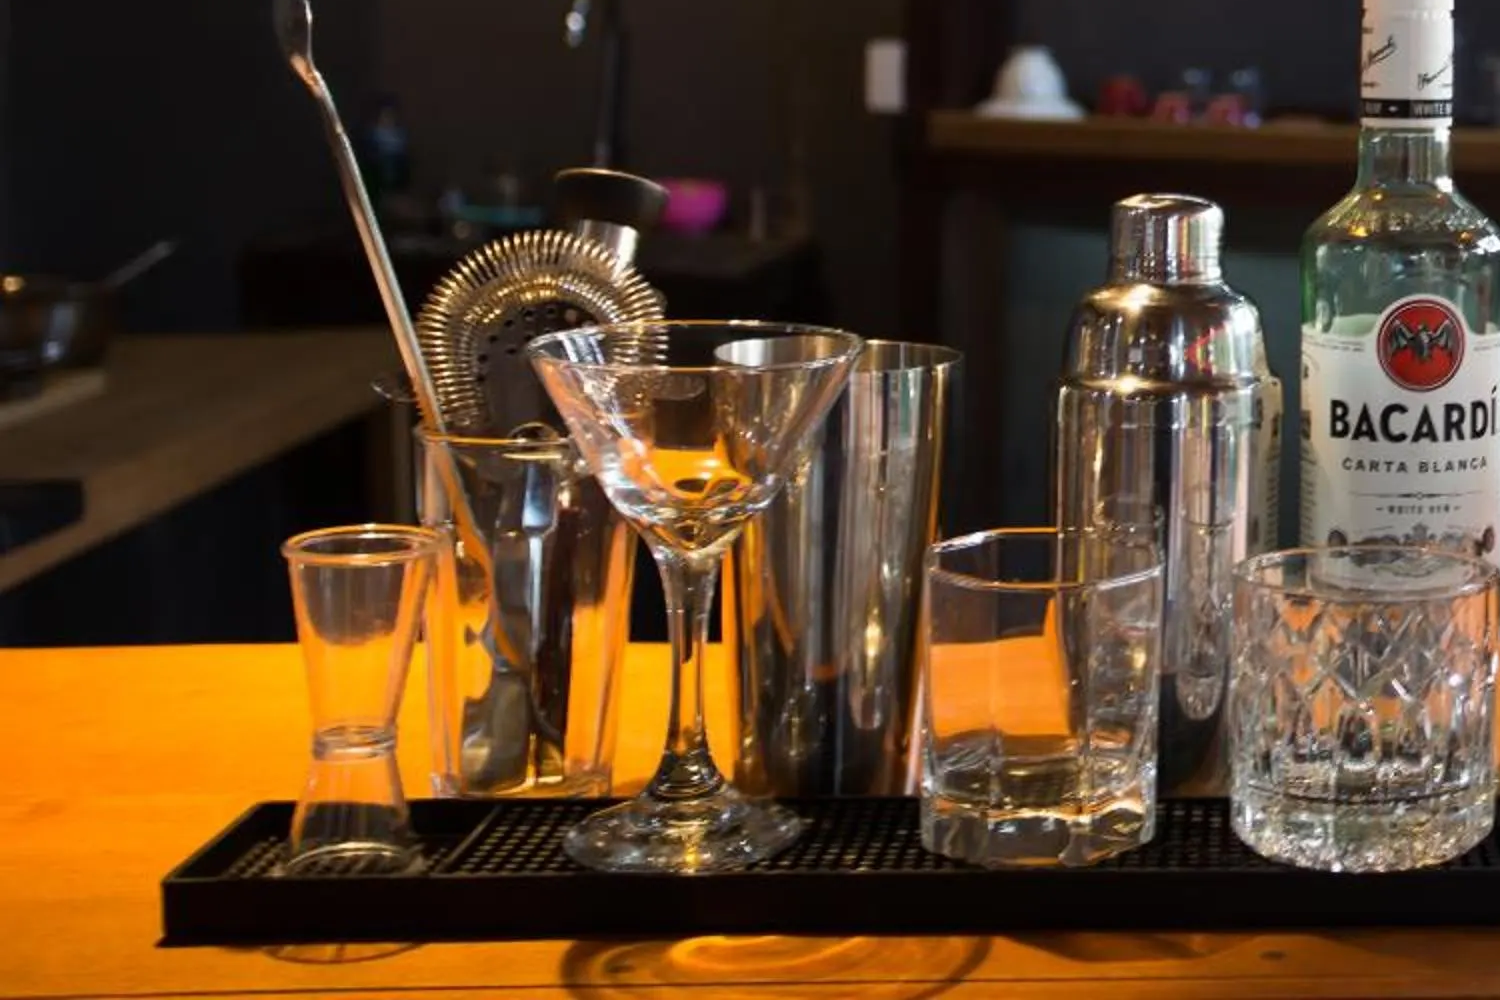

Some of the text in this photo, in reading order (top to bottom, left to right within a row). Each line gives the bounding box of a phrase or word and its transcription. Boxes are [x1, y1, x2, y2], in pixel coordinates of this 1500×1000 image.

[1329, 386, 1497, 443] BACARDÍ
[1341, 455, 1488, 474] CARTA BLANCA
